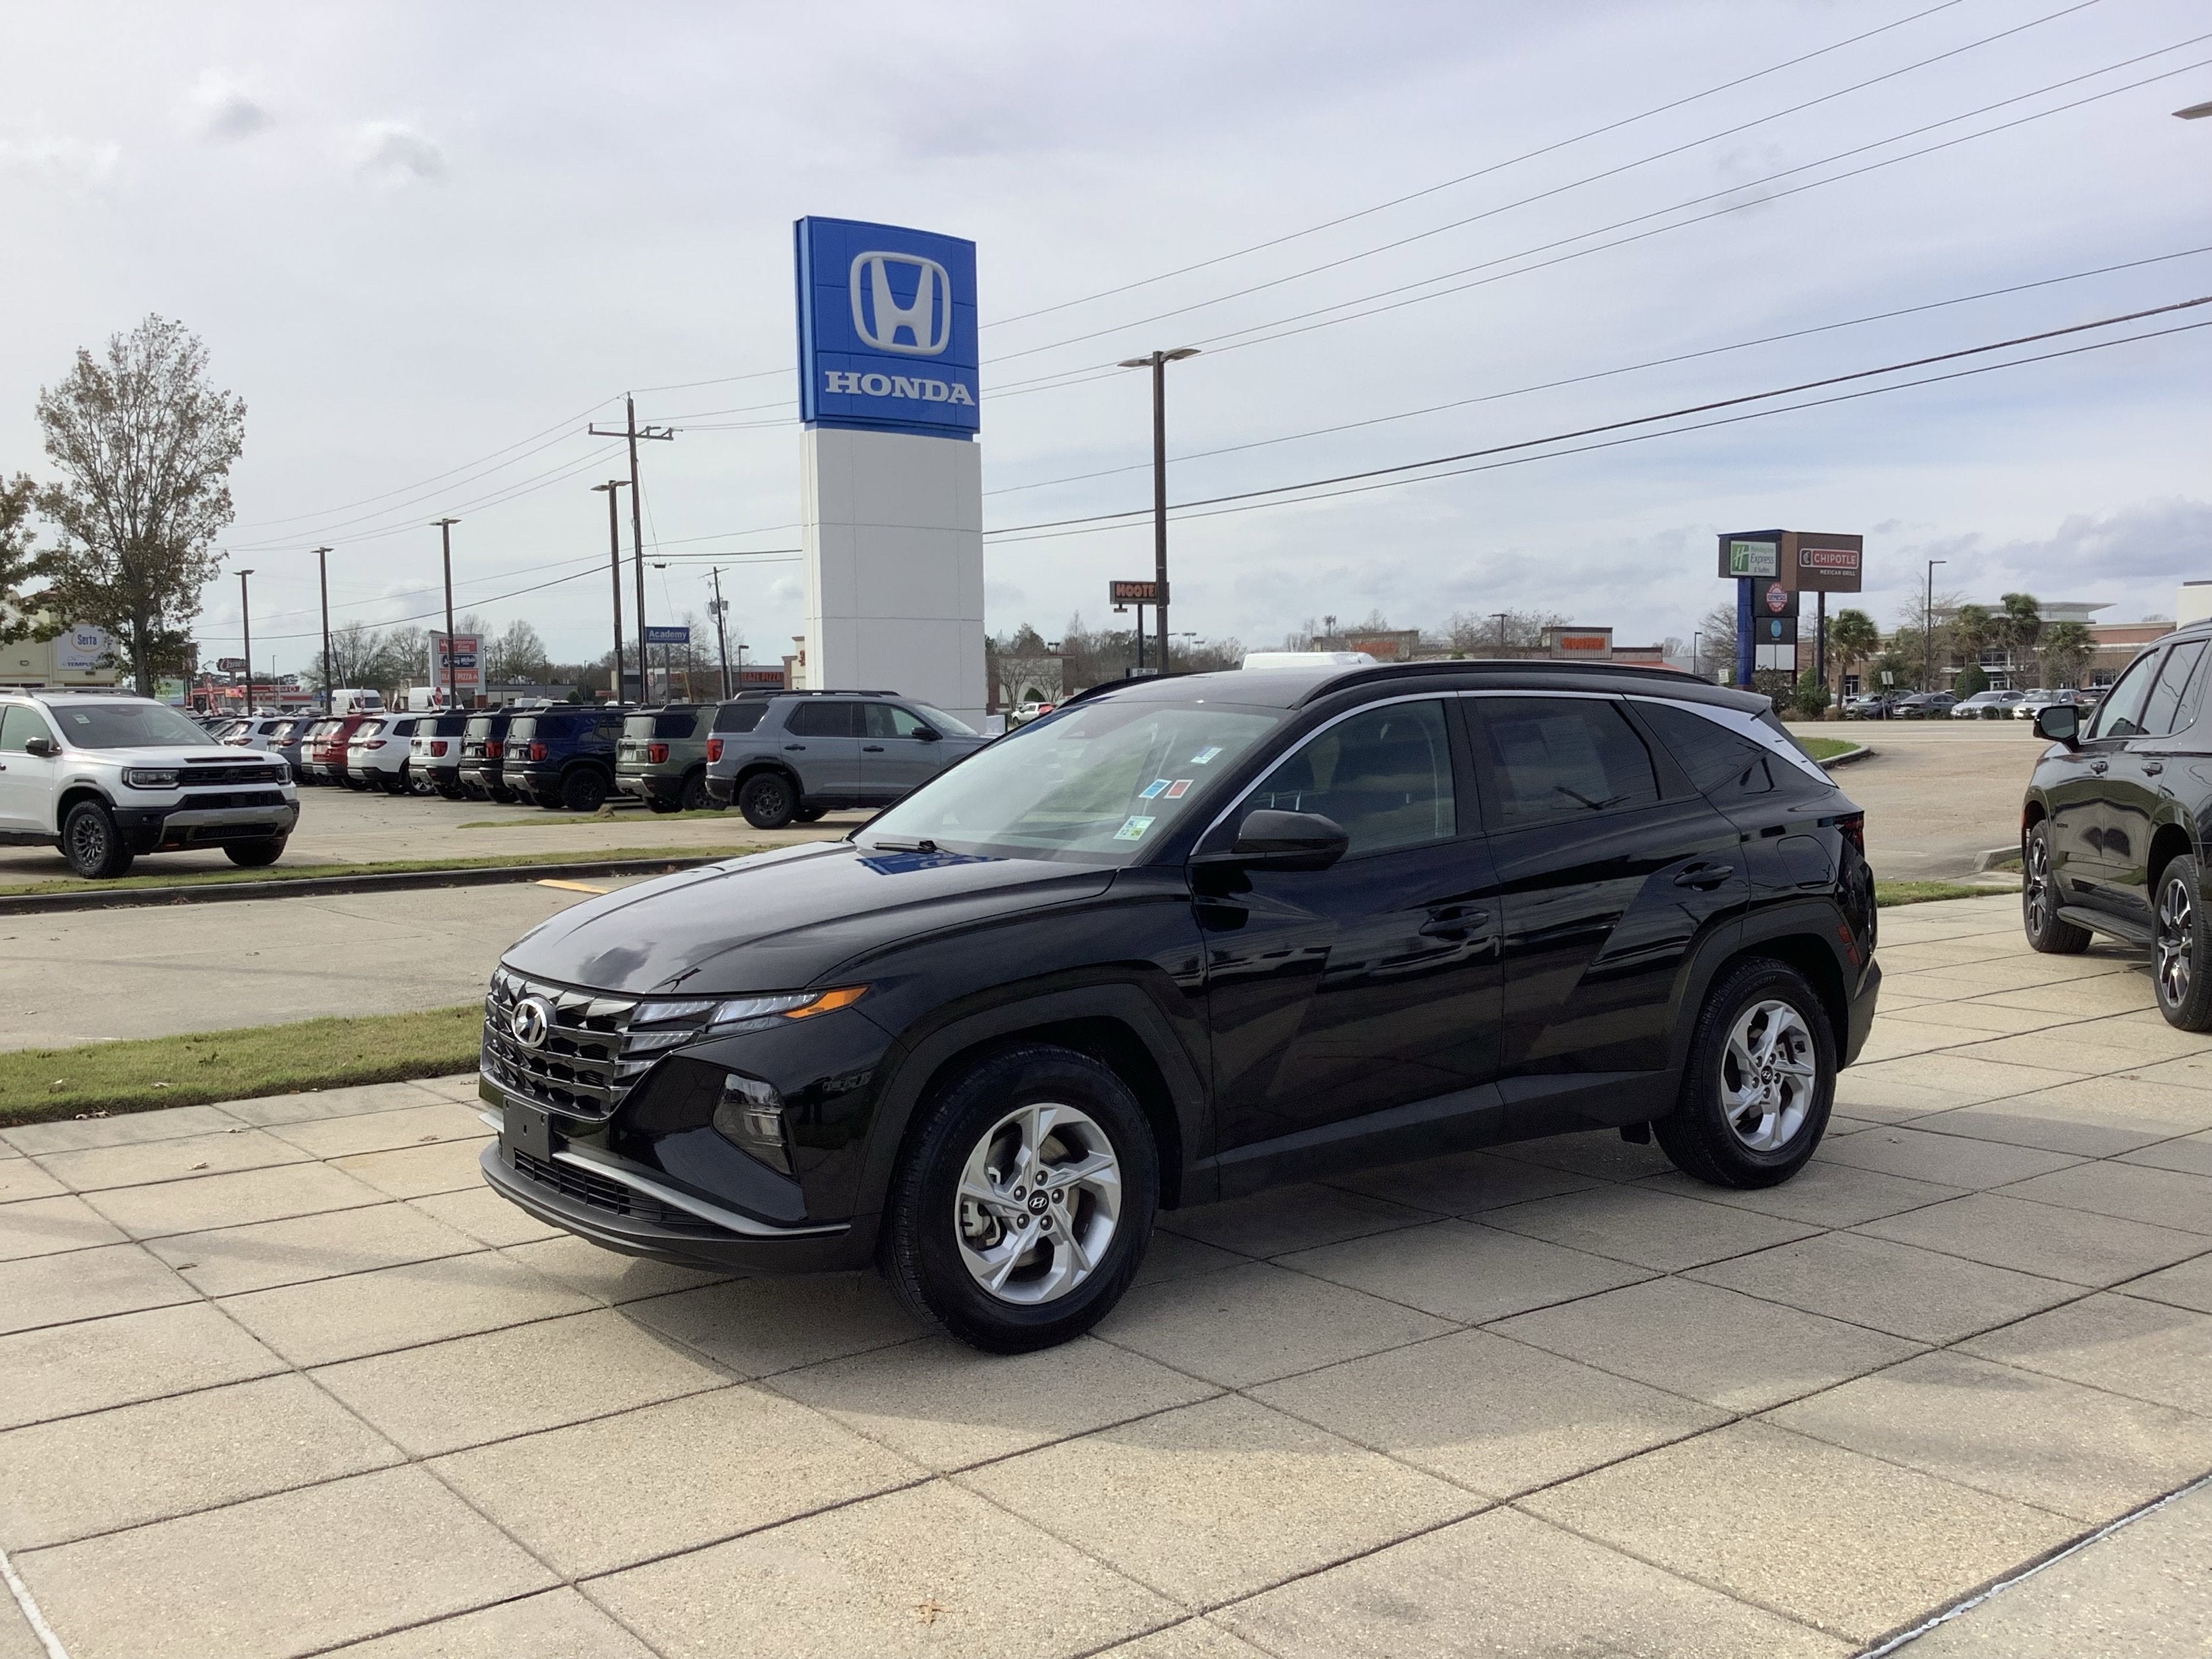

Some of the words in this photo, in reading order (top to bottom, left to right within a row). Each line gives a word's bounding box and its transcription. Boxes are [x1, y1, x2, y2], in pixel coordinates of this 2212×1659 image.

[824, 371, 976, 406] HONDA
[1750, 553, 1774, 565] Express
[1814, 553, 1856, 565] CHIPOTLE
[77, 634, 98, 645] Serta
[649, 630, 687, 640] Academy
